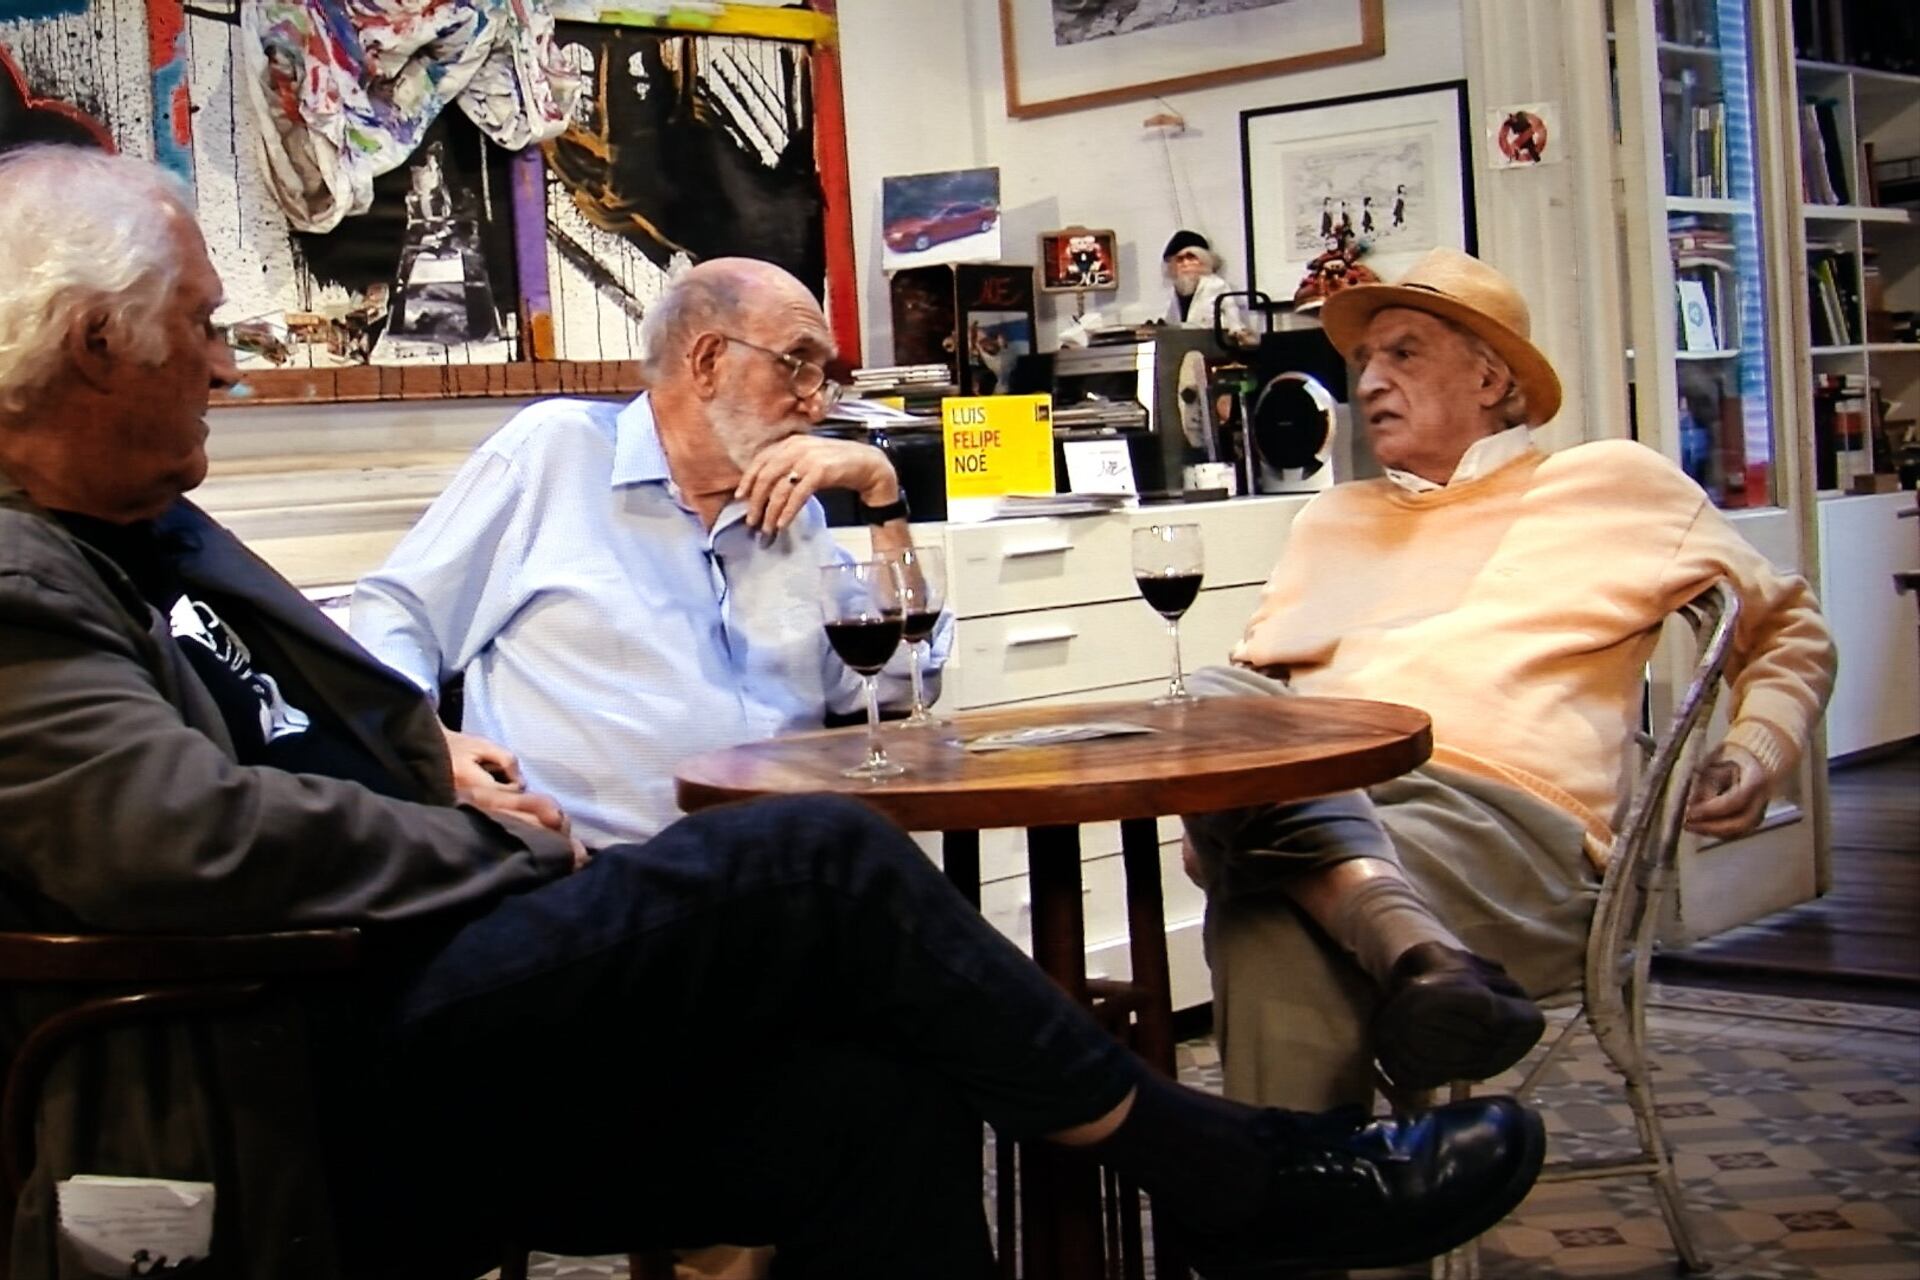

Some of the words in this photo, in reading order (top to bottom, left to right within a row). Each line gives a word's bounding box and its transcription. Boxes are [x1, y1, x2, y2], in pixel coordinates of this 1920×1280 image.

[952, 406, 986, 425] LUIS
[953, 430, 1002, 449] FELIPE
[955, 448, 988, 473] NOÉ
